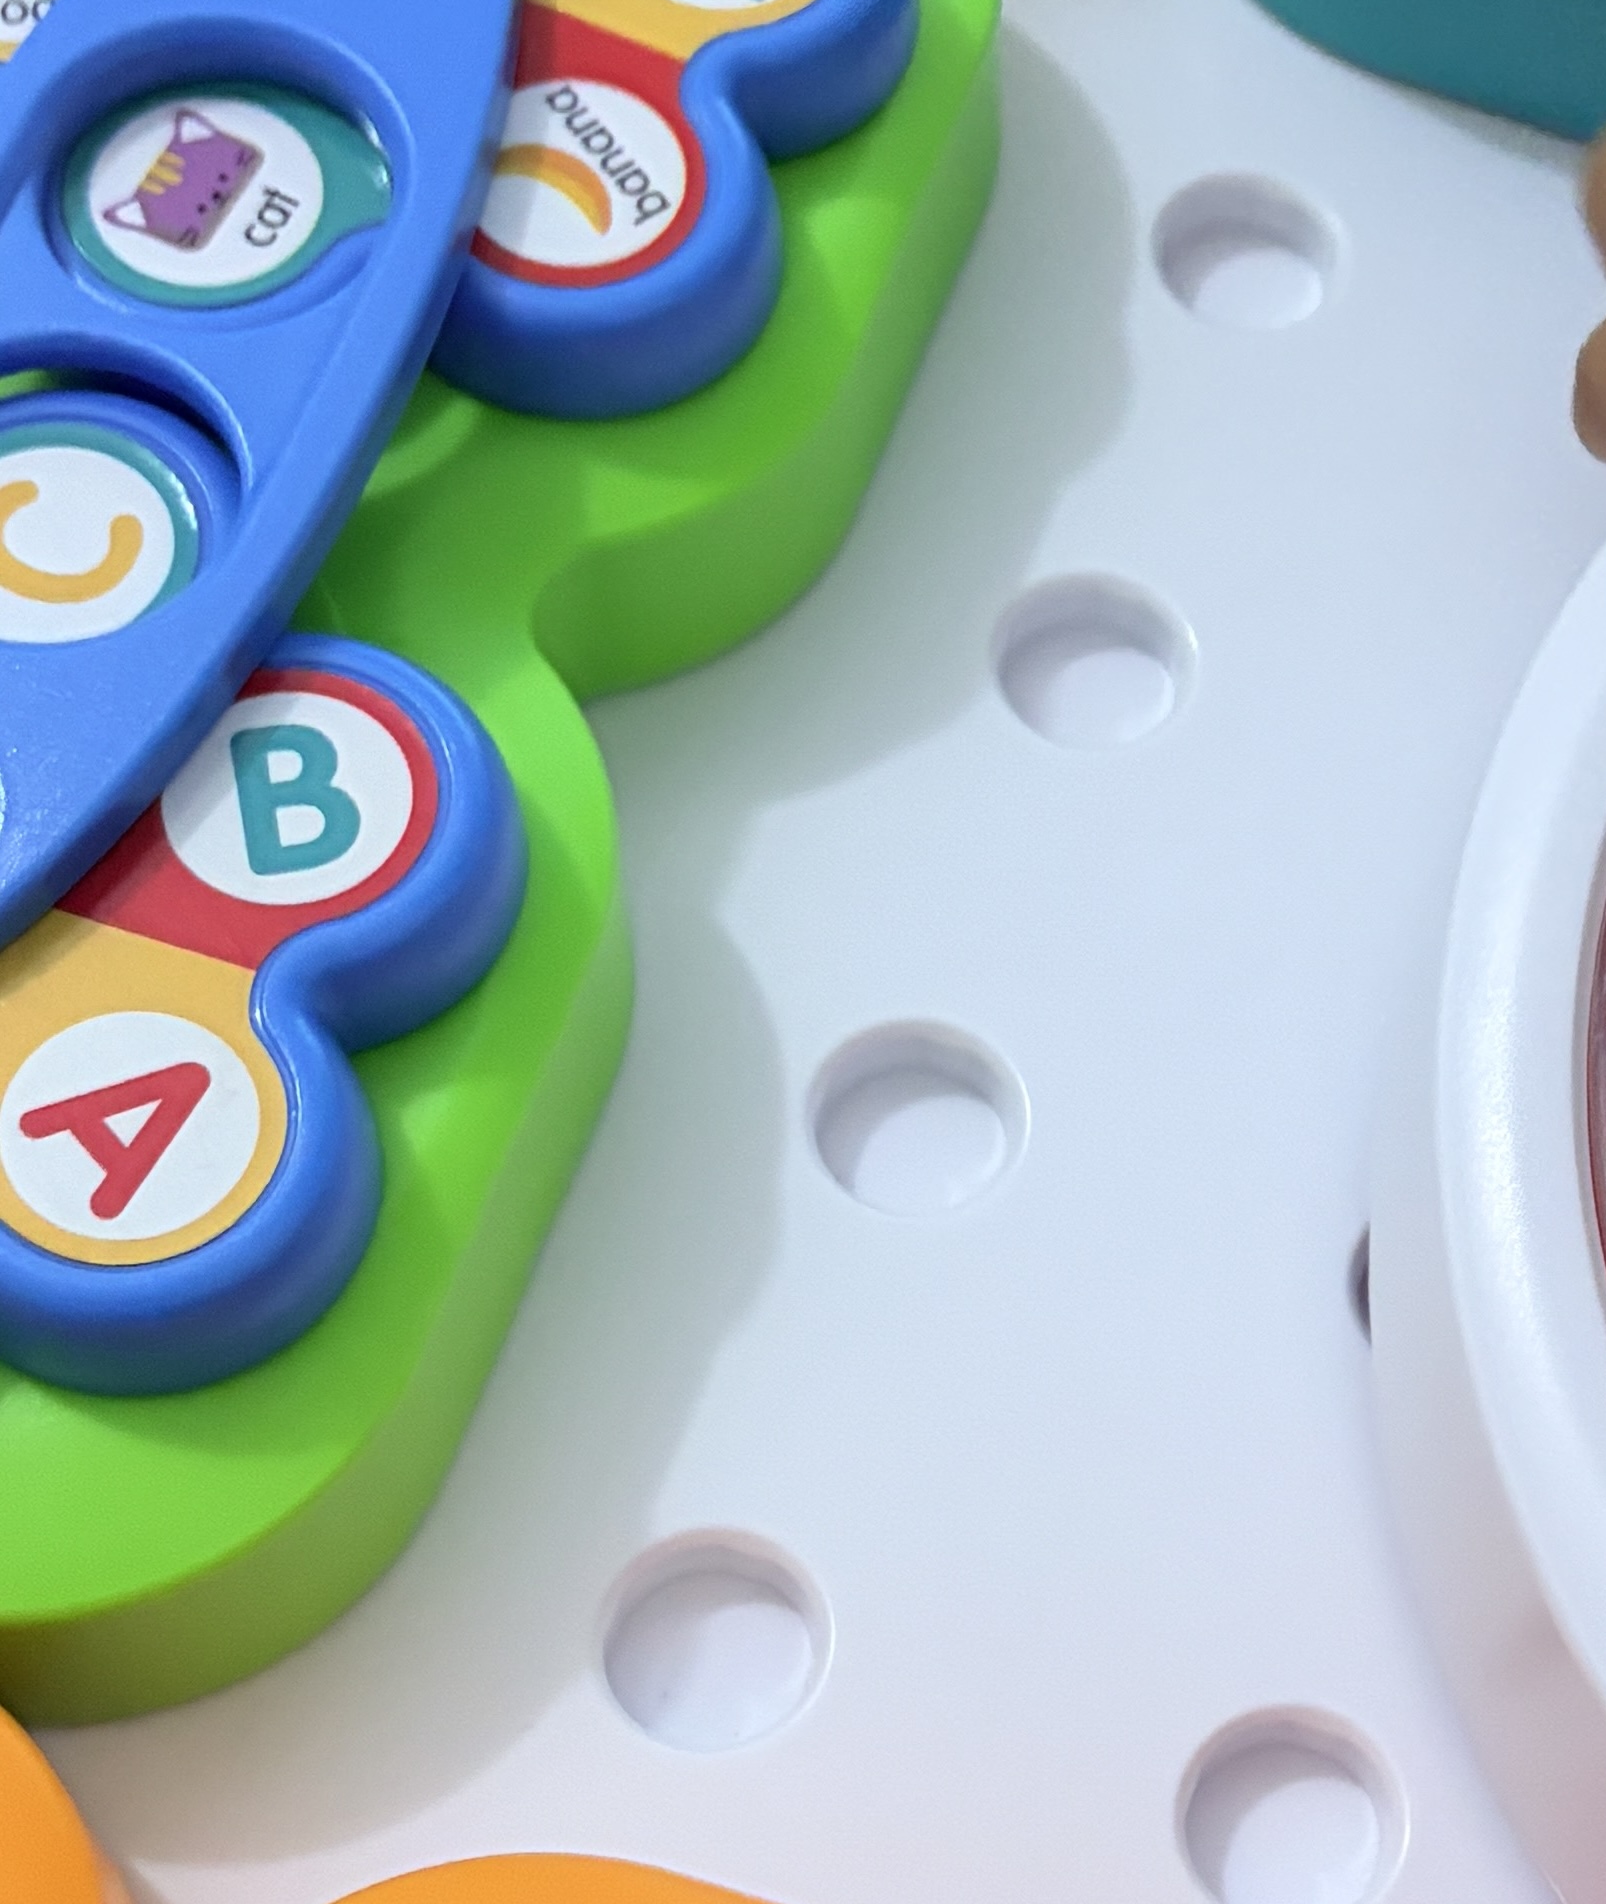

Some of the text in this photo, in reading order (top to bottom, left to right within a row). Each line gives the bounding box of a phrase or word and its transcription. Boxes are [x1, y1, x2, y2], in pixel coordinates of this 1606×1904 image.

[244, 187, 300, 247] cat
[545, 85, 671, 226] banana
[0, 480, 144, 603] C
[230, 724, 361, 876] B
[20, 1061, 211, 1220] A
